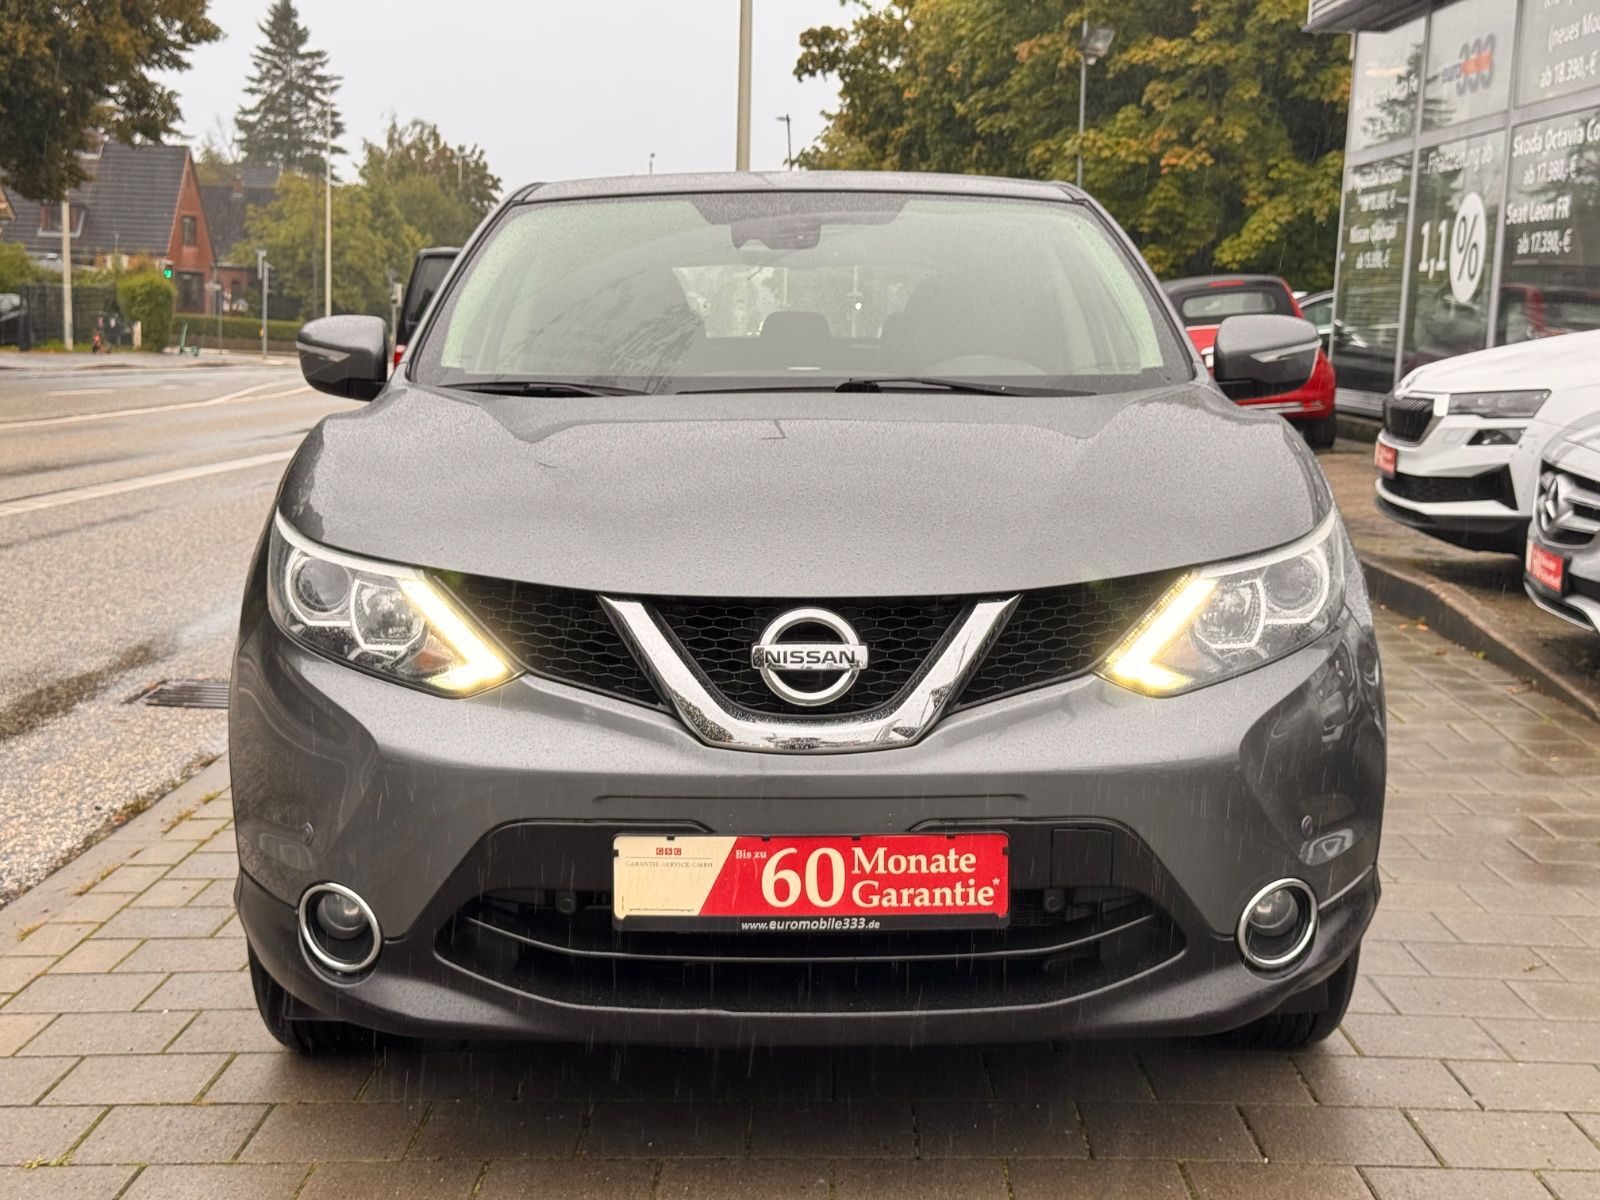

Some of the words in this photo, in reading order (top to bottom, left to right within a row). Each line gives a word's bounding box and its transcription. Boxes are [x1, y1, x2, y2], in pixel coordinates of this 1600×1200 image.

[1581, 11, 1600, 35] Mo
[1540, 64, 1552, 88] ab
[1544, 120, 1584, 151] Octavia
[1523, 163, 1535, 185] ab
[1505, 202, 1528, 225] Seat
[1529, 200, 1554, 222] Leon
[1555, 194, 1571, 219] FR
[1418, 219, 1448, 281] 1,1
[1517, 231, 1530, 256] ab
[765, 650, 855, 664] NISSAN
[735, 850, 752, 859] Bis
[754, 850, 767, 859] zu
[761, 847, 845, 908] 60
[851, 847, 977, 874] Monate
[741, 917, 881, 930] www.euromobile333.de
